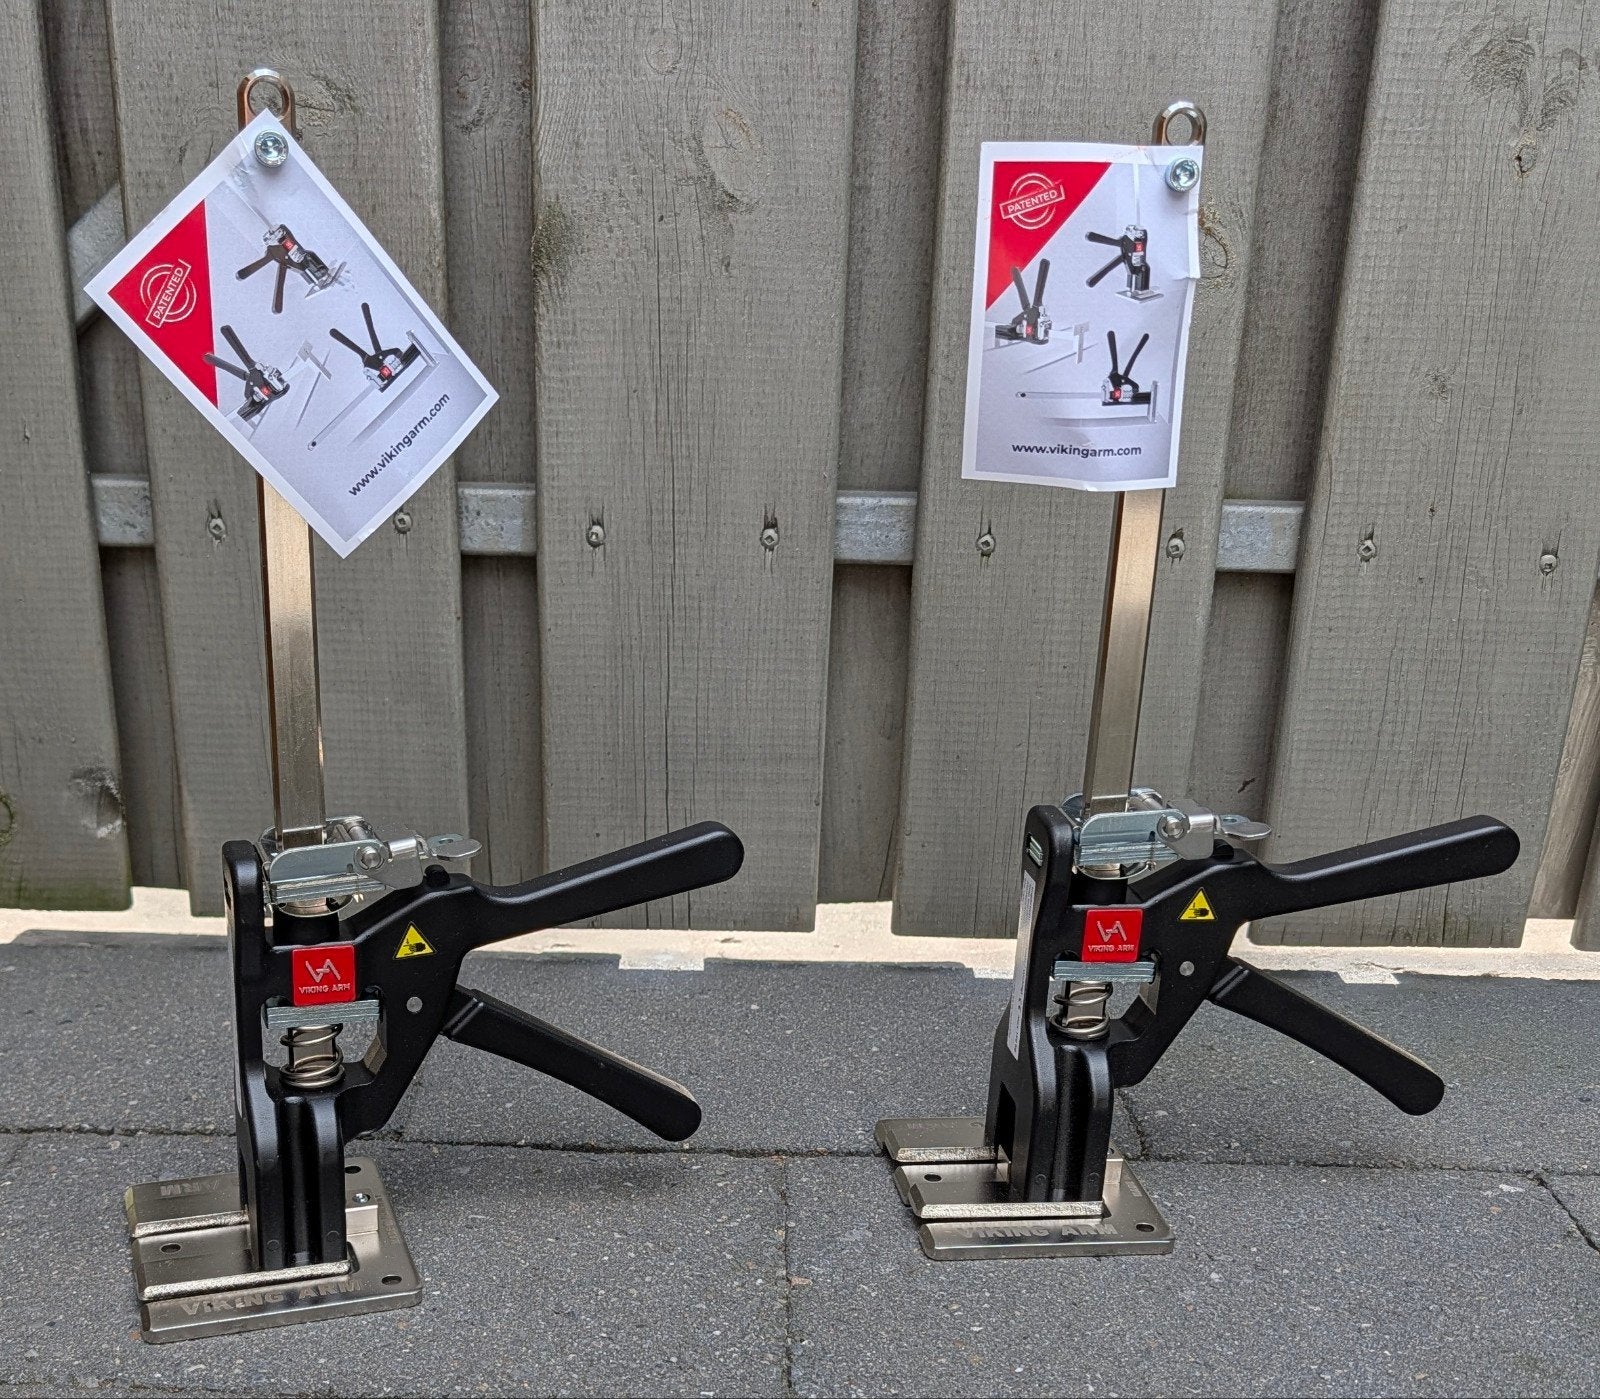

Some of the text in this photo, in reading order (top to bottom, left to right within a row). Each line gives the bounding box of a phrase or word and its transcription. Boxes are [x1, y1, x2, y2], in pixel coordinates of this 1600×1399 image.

[1007, 189, 1058, 214] PATENTED
[153, 267, 184, 320] PATENTED
[348, 393, 451, 496] www.vikingarm.com
[1011, 443, 1143, 459] www.vikingarm.com
[1087, 944, 1135, 953] VIKING ARM
[298, 982, 351, 994] VIKING ARM
[957, 1223, 1119, 1239] VIKING ARM
[179, 1279, 362, 1317] VIKING ARM
